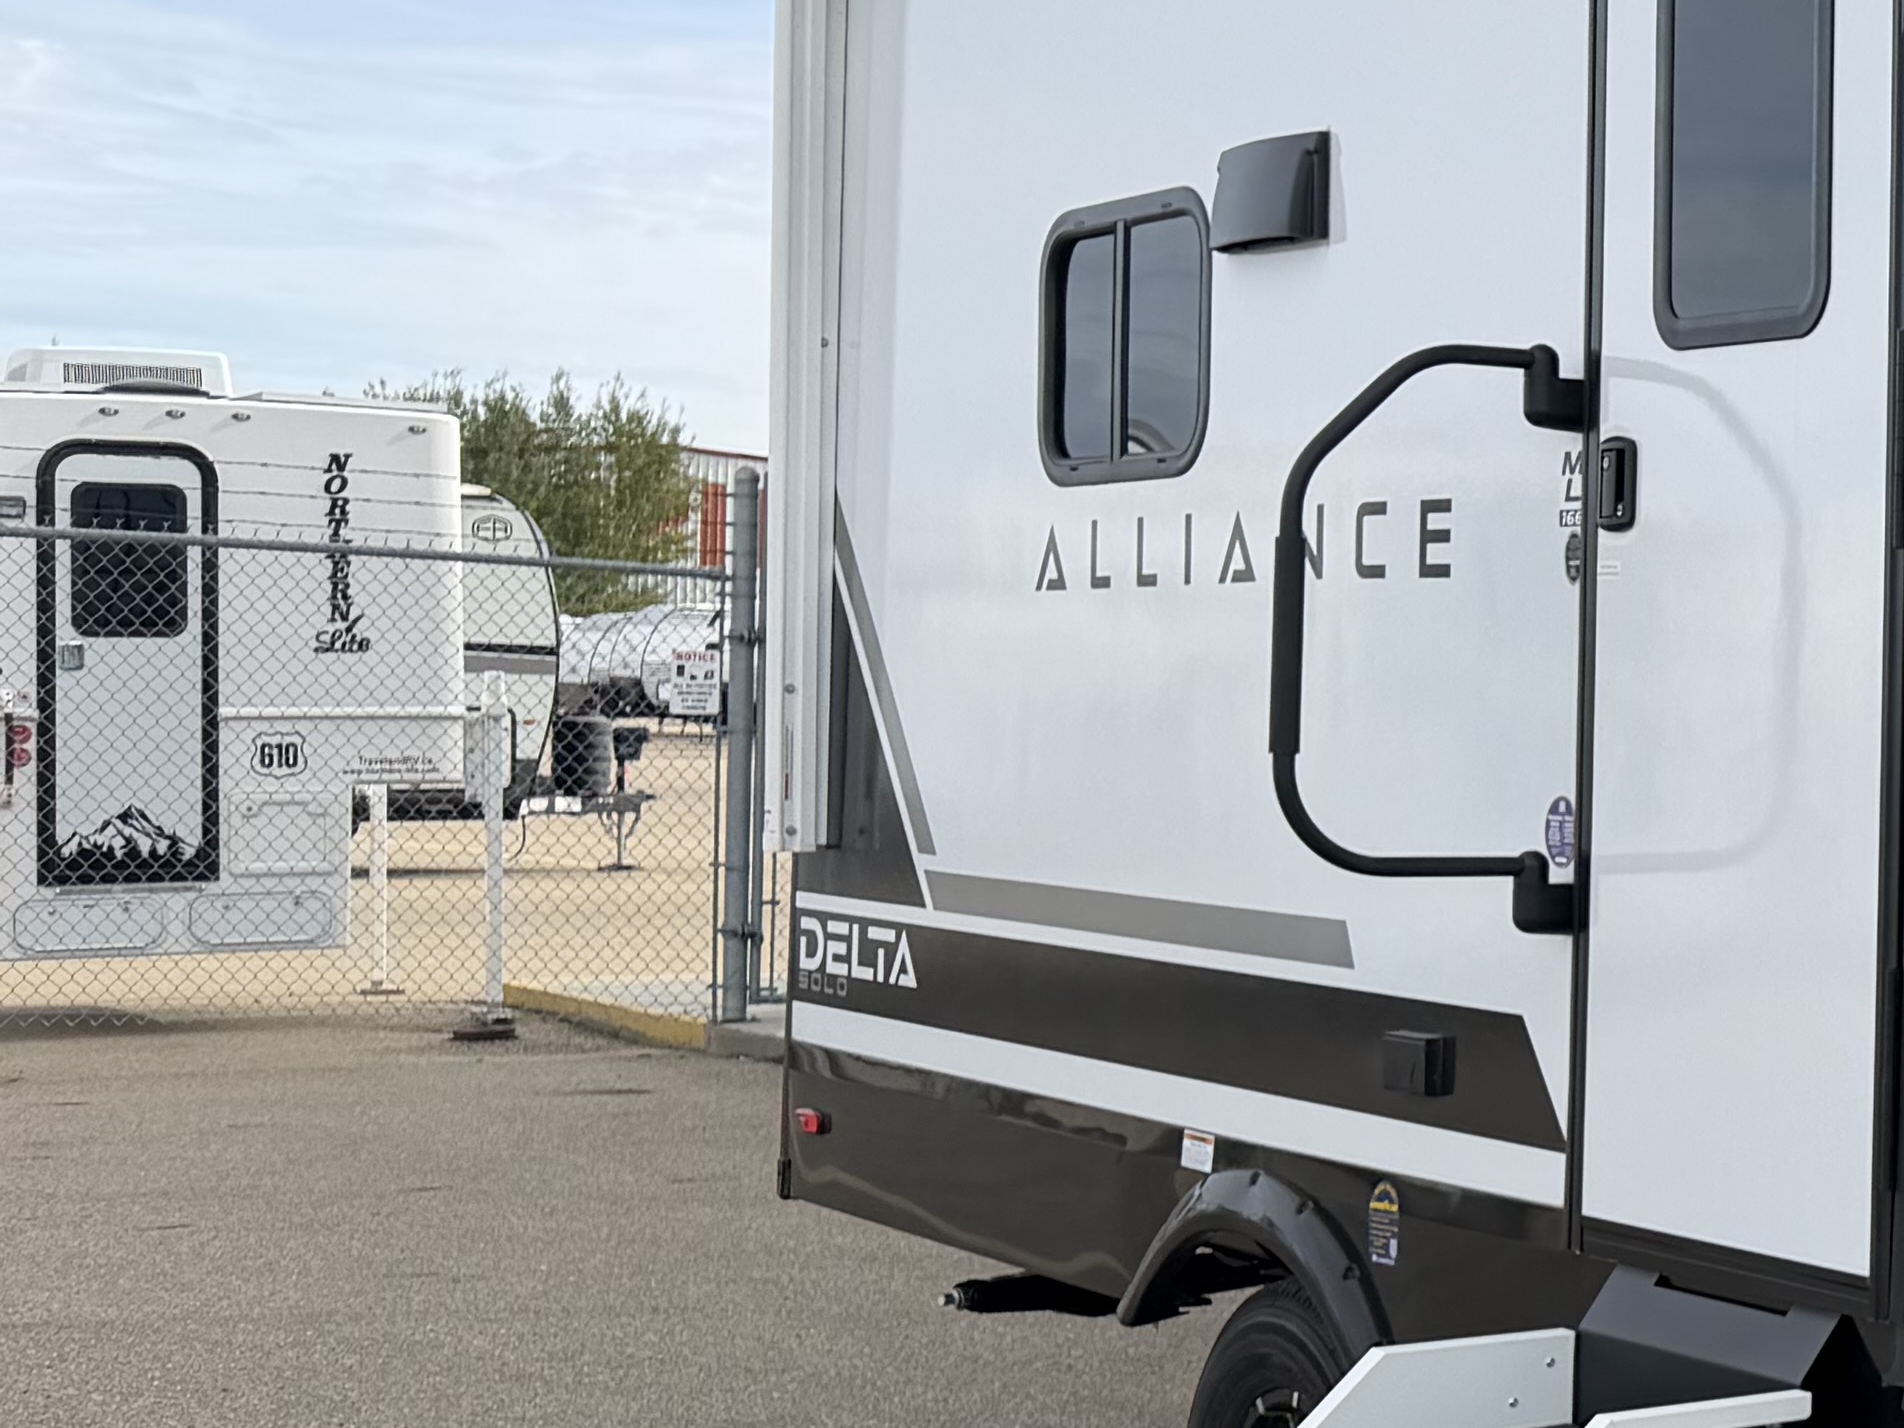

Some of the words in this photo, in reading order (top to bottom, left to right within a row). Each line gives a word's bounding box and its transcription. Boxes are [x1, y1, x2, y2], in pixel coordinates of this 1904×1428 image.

[1035, 498, 1453, 592] ALLIANCE
[259, 742, 299, 769] 610
[799, 915, 918, 989] DELTA
[798, 970, 848, 998] SOLO
